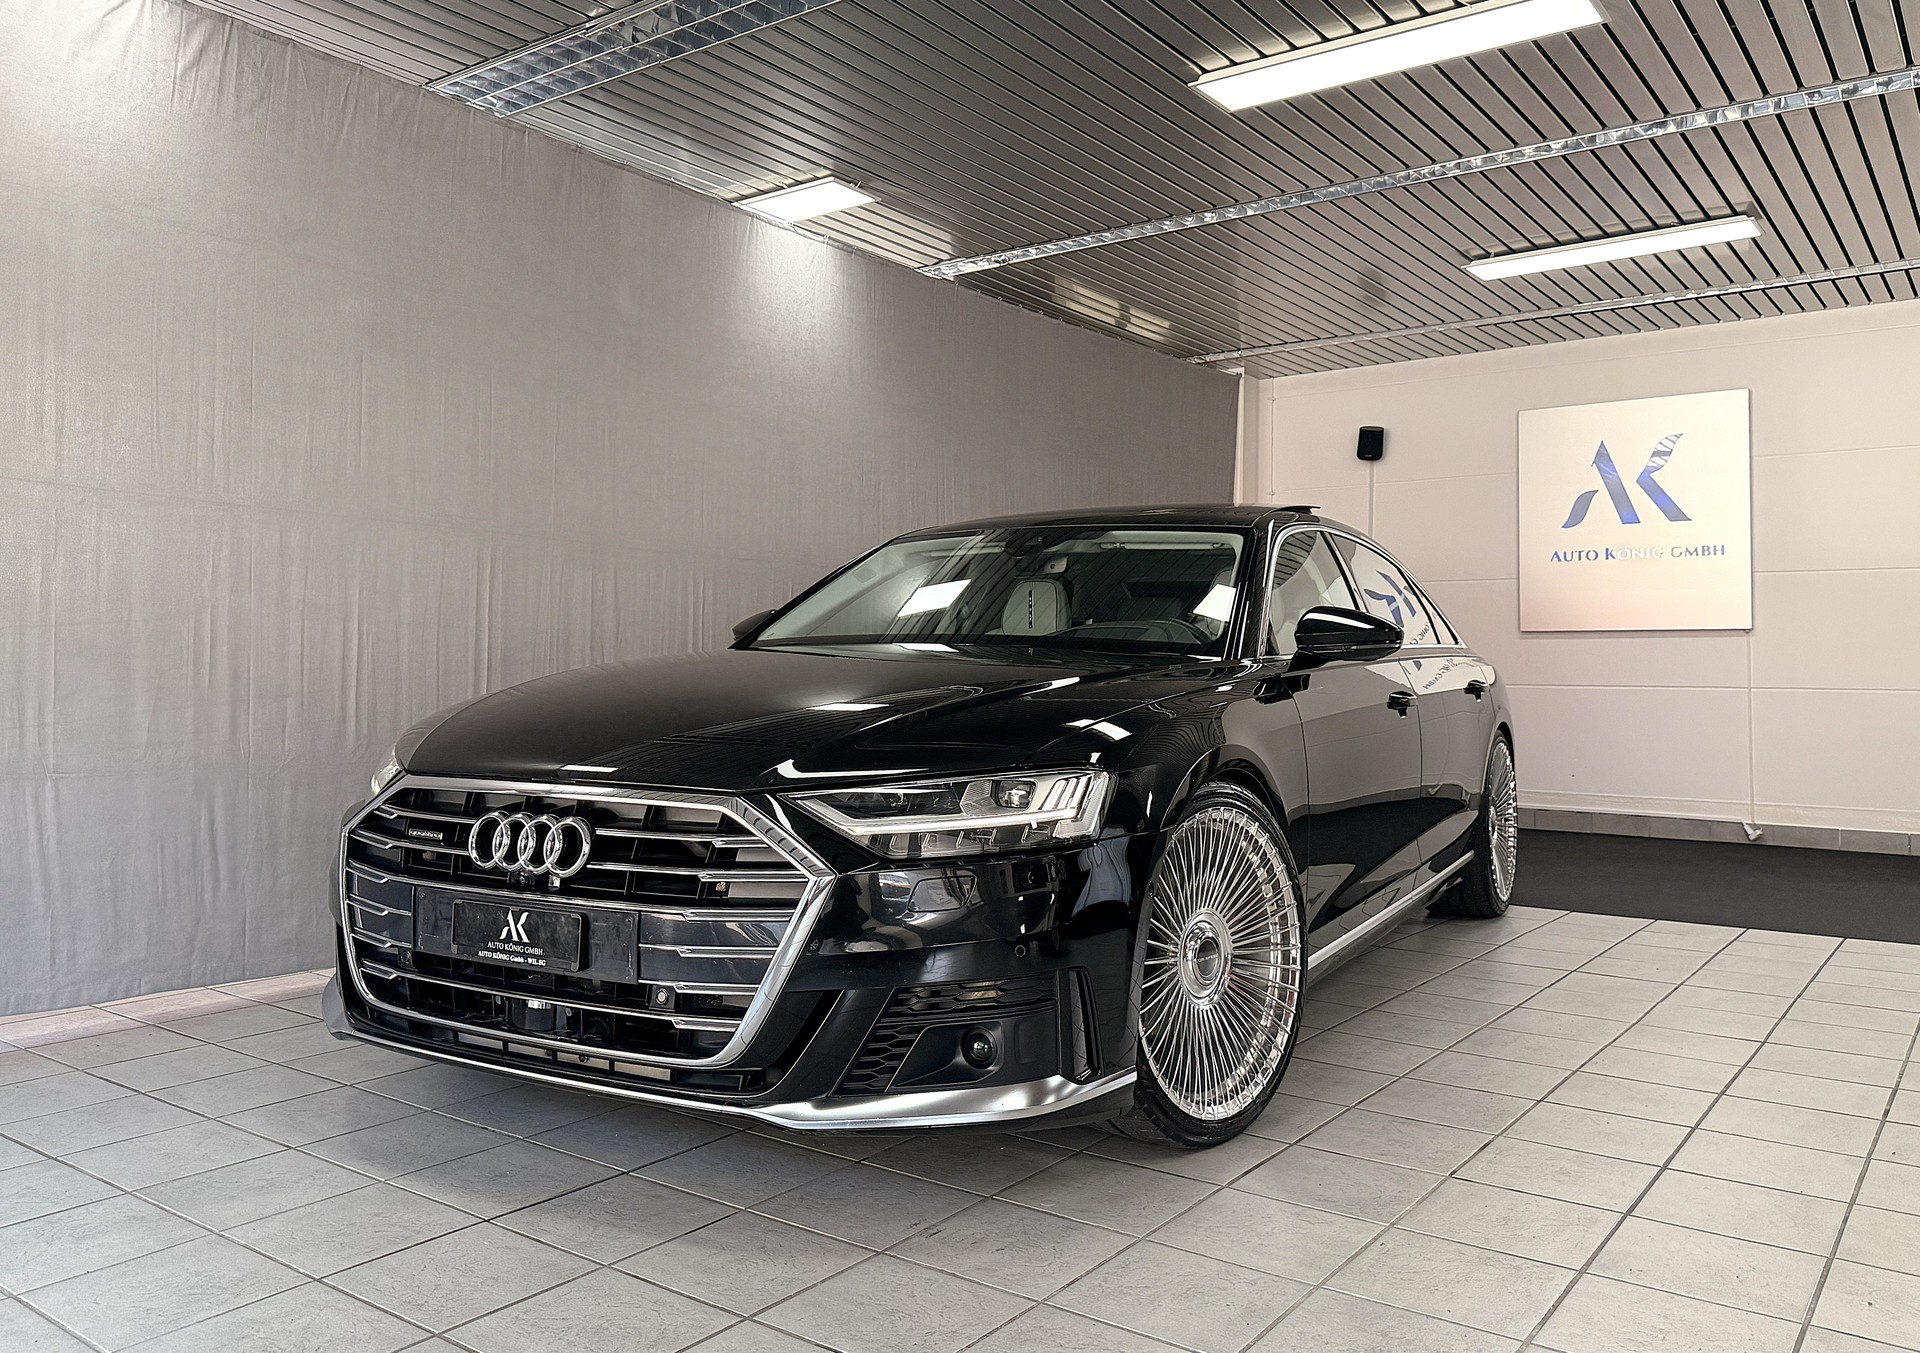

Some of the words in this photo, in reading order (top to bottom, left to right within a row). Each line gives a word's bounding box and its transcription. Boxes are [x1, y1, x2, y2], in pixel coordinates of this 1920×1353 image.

[1561, 433, 1692, 528] AK
[1550, 549, 1599, 563] AUTO
[1604, 545, 1664, 561] KÖNIG
[1670, 545, 1725, 559] GMBH
[499, 910, 530, 943] AK
[477, 950, 493, 958] AUTO
[492, 952, 510, 961] KÖNIG
[487, 941, 504, 950] AUTO
[504, 943, 524, 953] KÖNIG
[524, 946, 543, 956] GMBH
